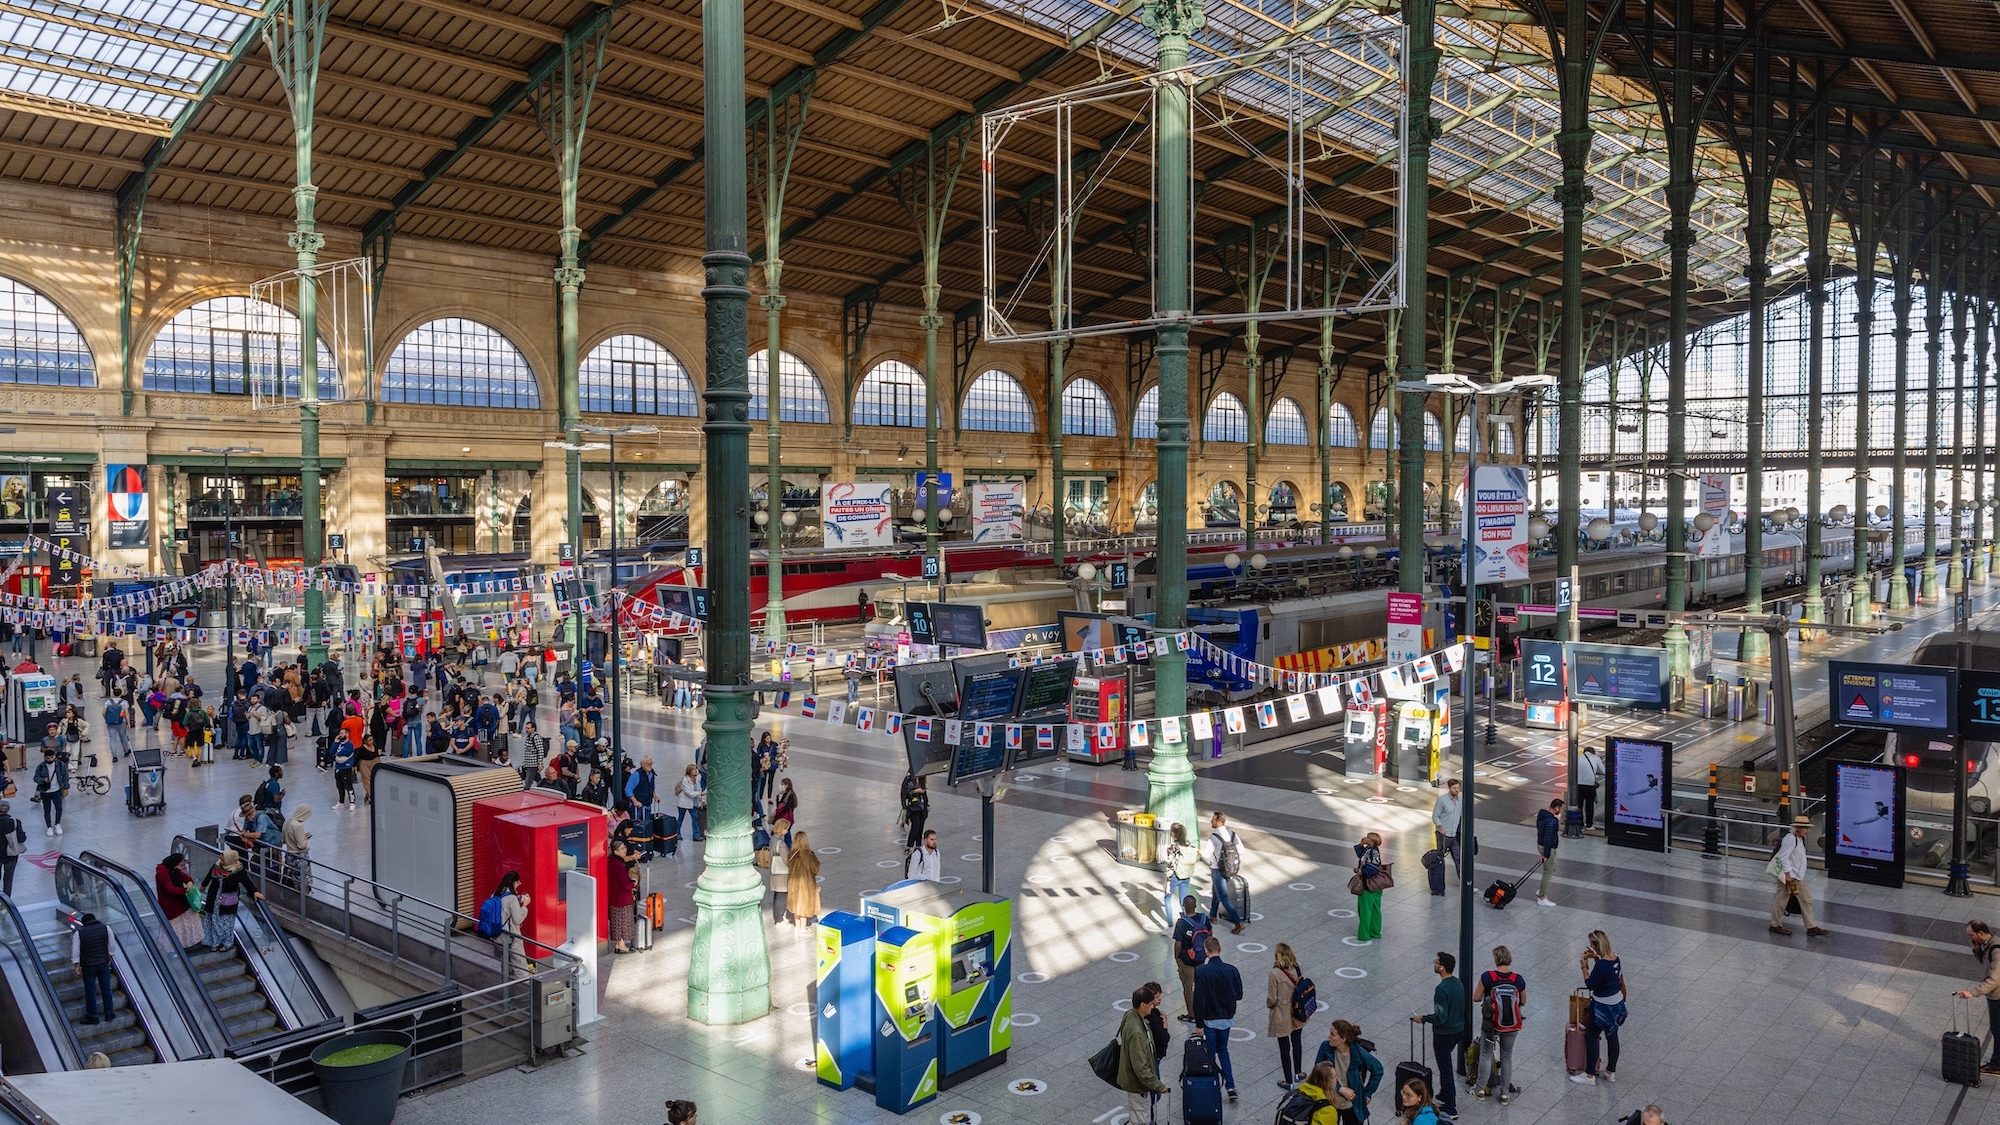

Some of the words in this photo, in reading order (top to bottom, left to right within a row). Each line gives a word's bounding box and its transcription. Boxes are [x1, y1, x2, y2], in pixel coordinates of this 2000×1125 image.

[1496, 490, 1511, 500] ÊTES
[1480, 516, 1514, 526] D'IMAGINER
[60, 538, 70, 548] P
[565, 549, 570, 557] 8
[691, 554, 698, 563] 9
[926, 563, 937, 574] 10
[1115, 571, 1125, 583] 11
[1560, 588, 1570, 603] 12
[699, 602, 705, 613] 9
[913, 618, 927, 631] 10
[1025, 633, 1038, 642] en
[1531, 663, 1556, 682] 12
